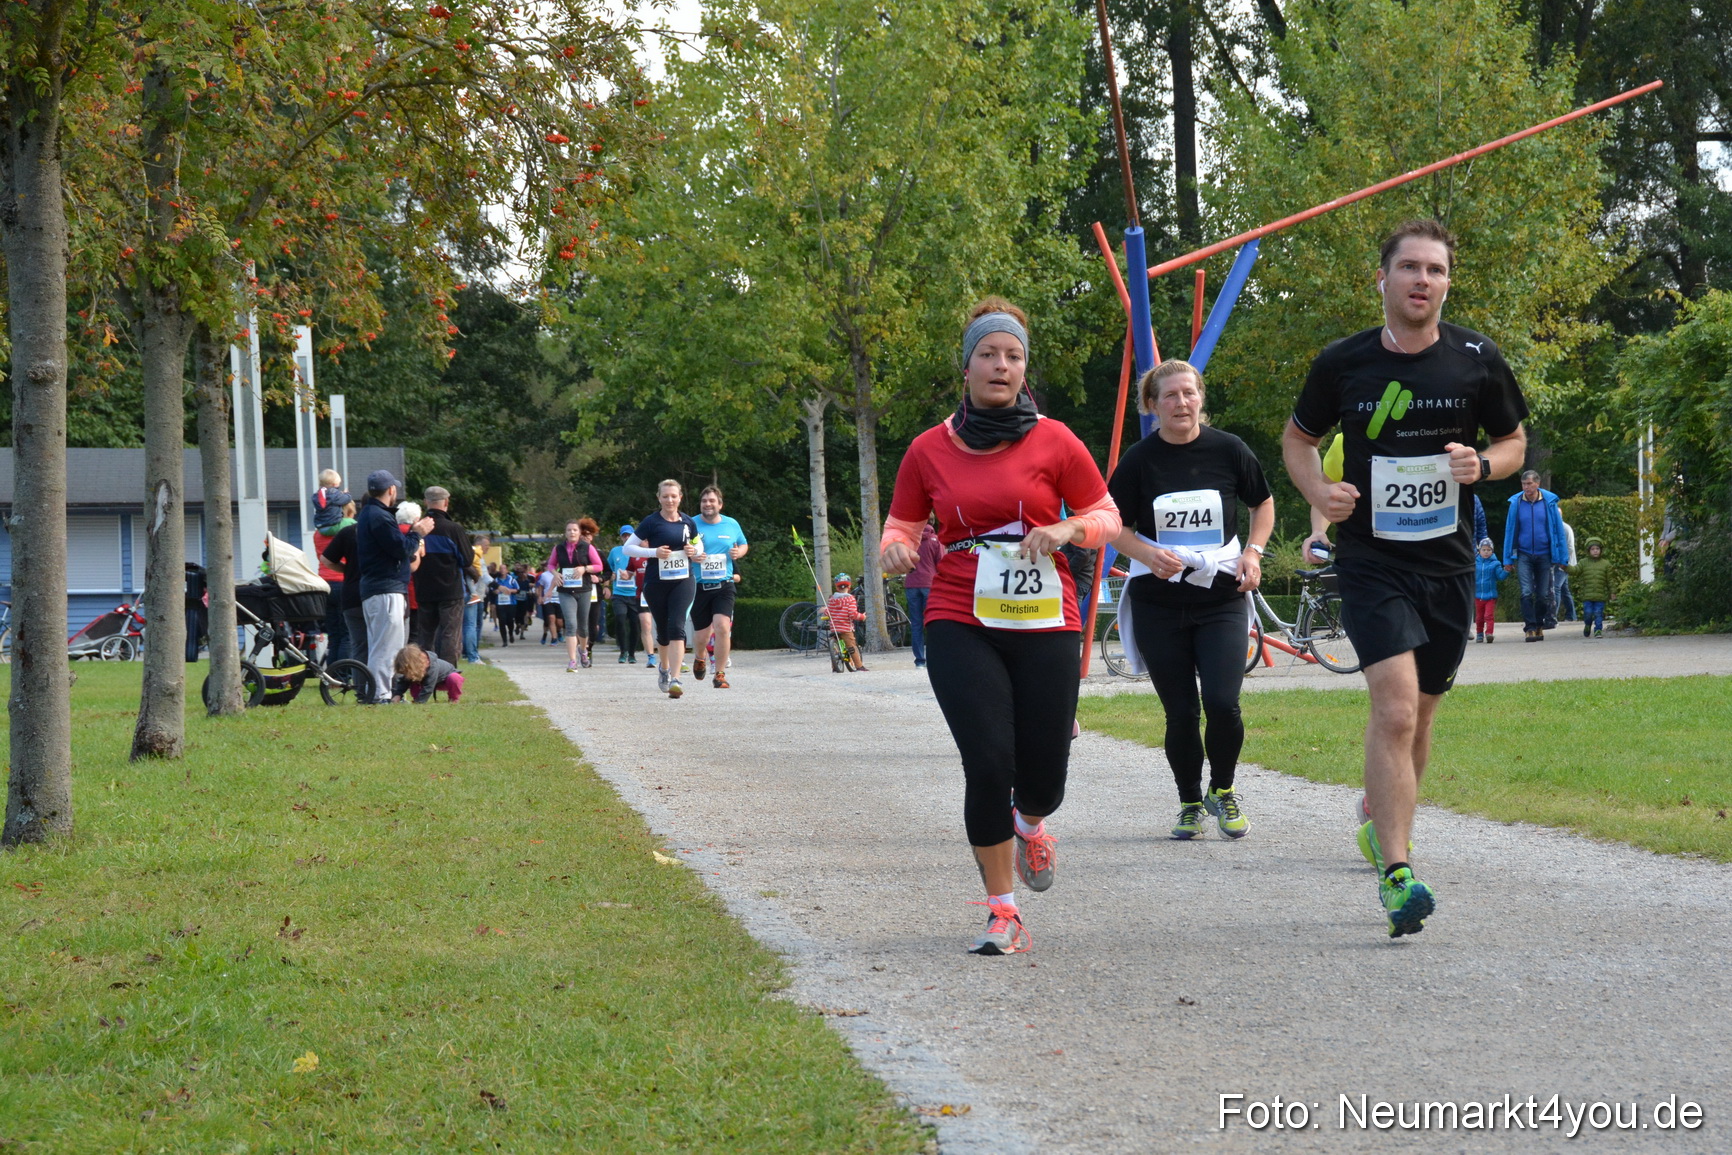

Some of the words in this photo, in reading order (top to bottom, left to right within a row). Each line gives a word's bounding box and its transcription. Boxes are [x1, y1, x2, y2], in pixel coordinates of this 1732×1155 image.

[1396, 429, 1419, 437] Secure
[1420, 428, 1439, 436] Cloud
[1385, 480, 1447, 509] 2369
[1164, 508, 1213, 529] 2744
[1396, 515, 1439, 527] Johannes
[663, 559, 685, 570] 2183
[704, 561, 723, 570] 2521
[999, 568, 1043, 595] 123
[1000, 603, 1039, 614] Christina
